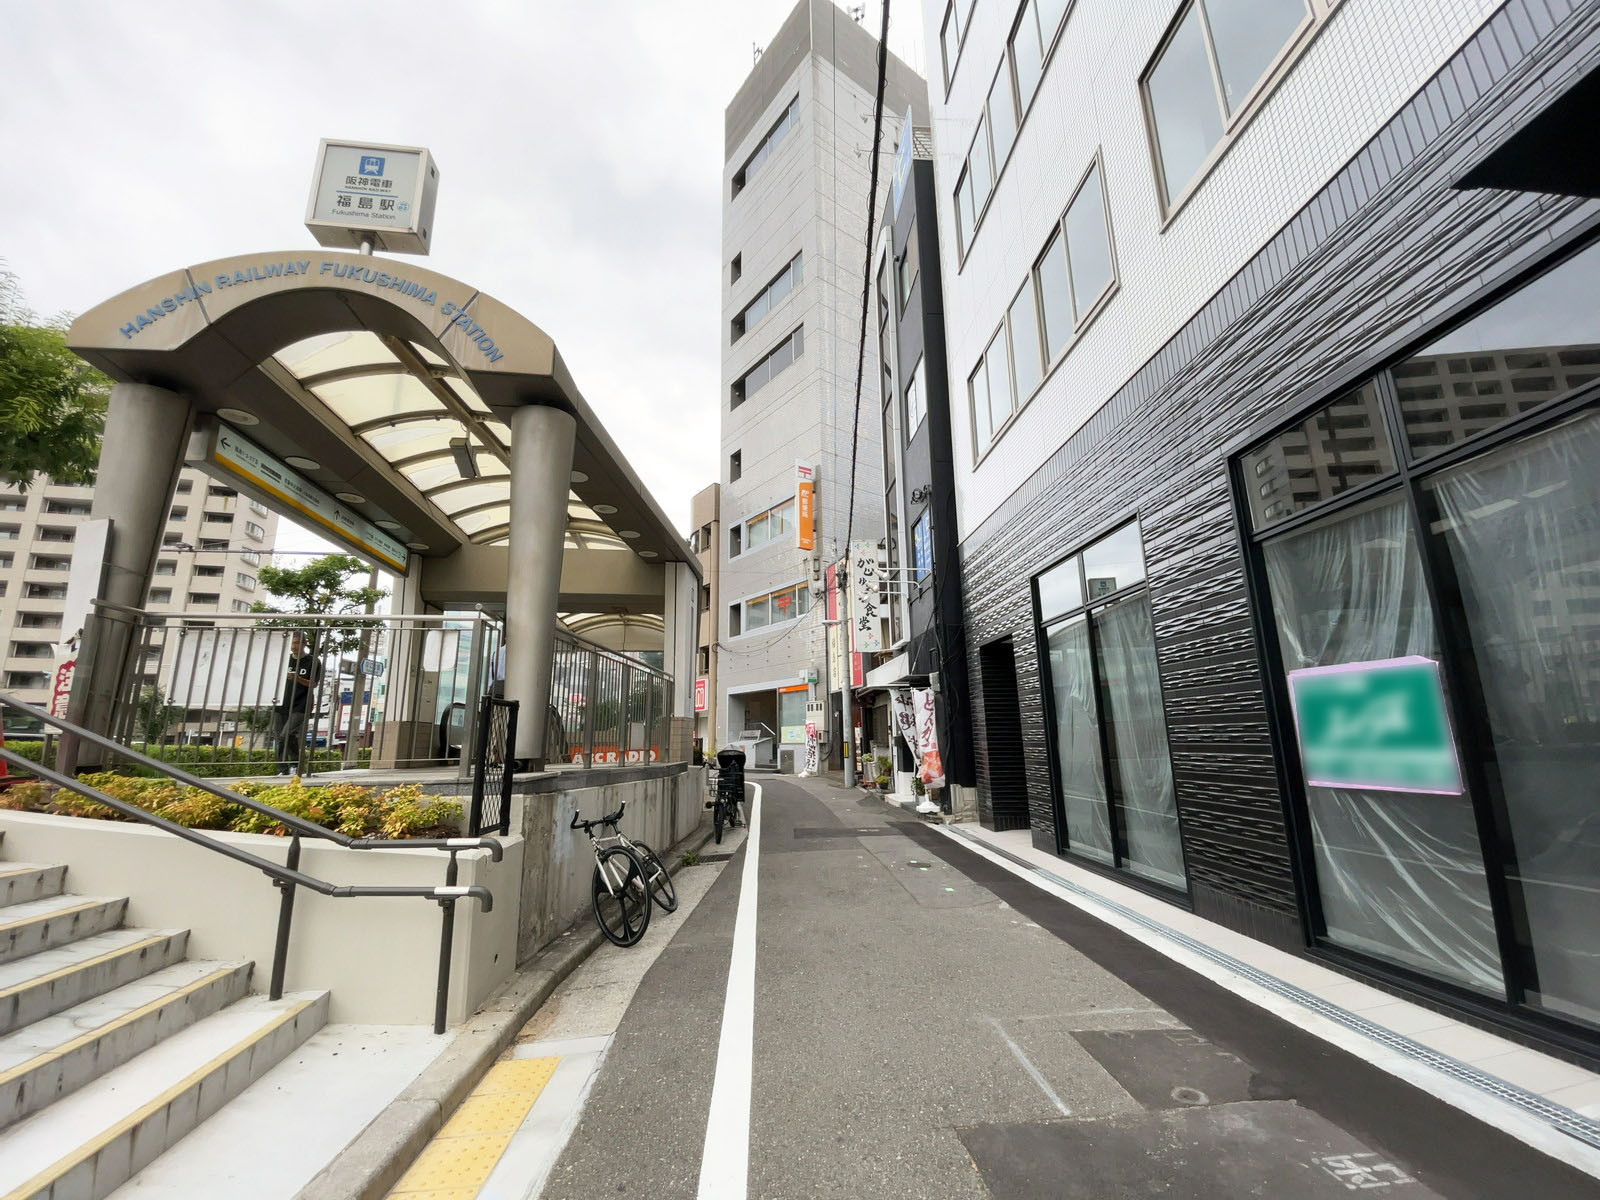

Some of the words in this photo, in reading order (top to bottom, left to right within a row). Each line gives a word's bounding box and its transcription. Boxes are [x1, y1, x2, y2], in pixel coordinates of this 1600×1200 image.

[345, 176, 392, 188] 阪神電車
[337, 195, 395, 211] 福島駅
[331, 208, 370, 218] Fukushima
[371, 212, 396, 220] Station
[119, 279, 213, 340] HANSHIN
[215, 260, 311, 290] RAILWAY
[319, 261, 438, 306] FUKUSHIMA
[440, 300, 504, 363] STATION
